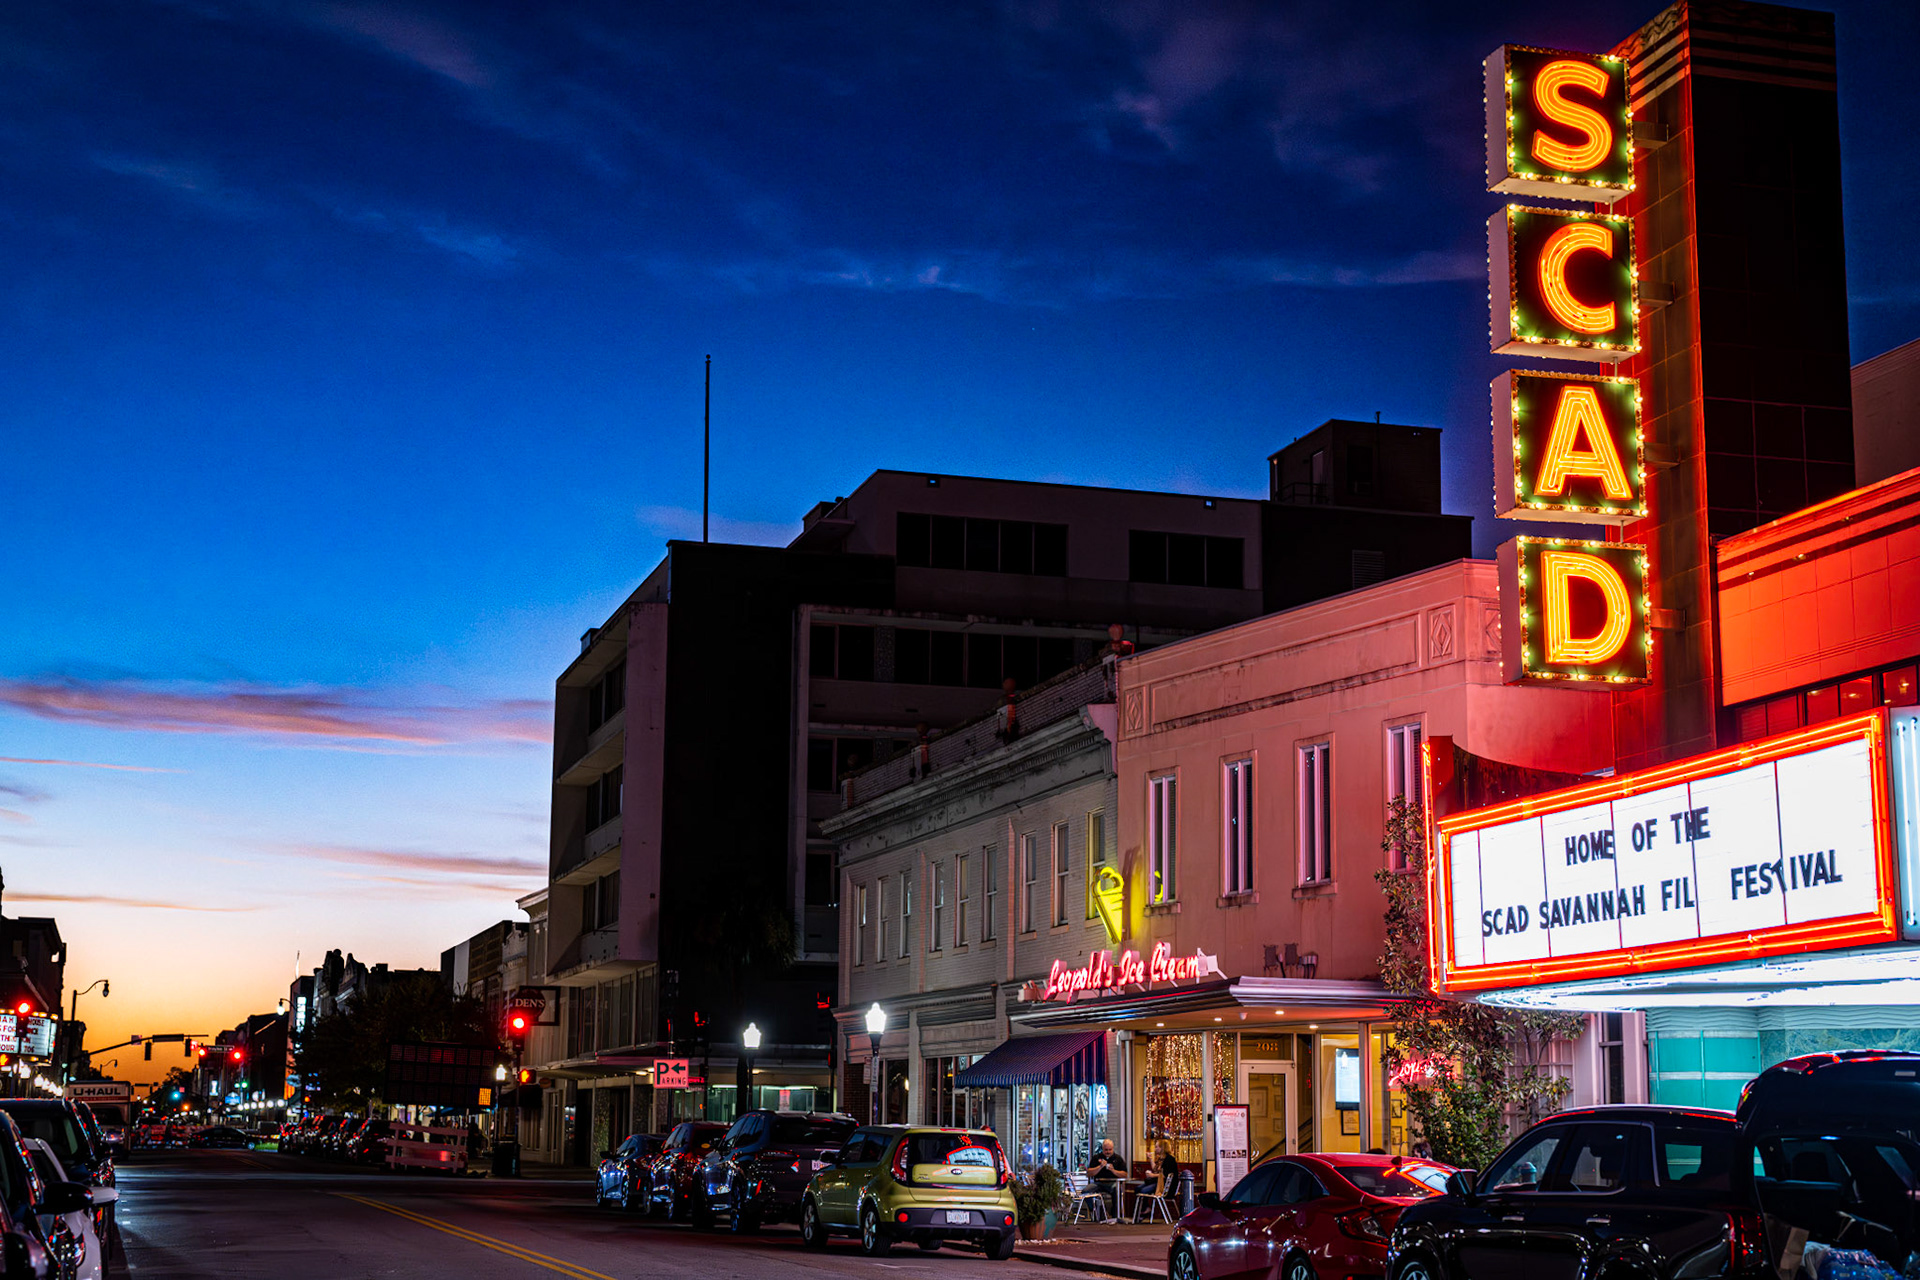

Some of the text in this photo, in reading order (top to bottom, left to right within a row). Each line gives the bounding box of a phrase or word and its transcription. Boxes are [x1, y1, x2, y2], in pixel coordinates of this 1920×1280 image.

[1530, 59, 1633, 664] SCAD
[1565, 806, 1711, 866] HOME OF THE
[1482, 849, 1843, 938] SCAD SAVANNAH FIL FESTIVAL
[1043, 941, 1201, 1004] Leopold's Ice Cream
[1255, 1042, 1278, 1052] 208
[73, 1088, 121, 1096] U-HAUL
